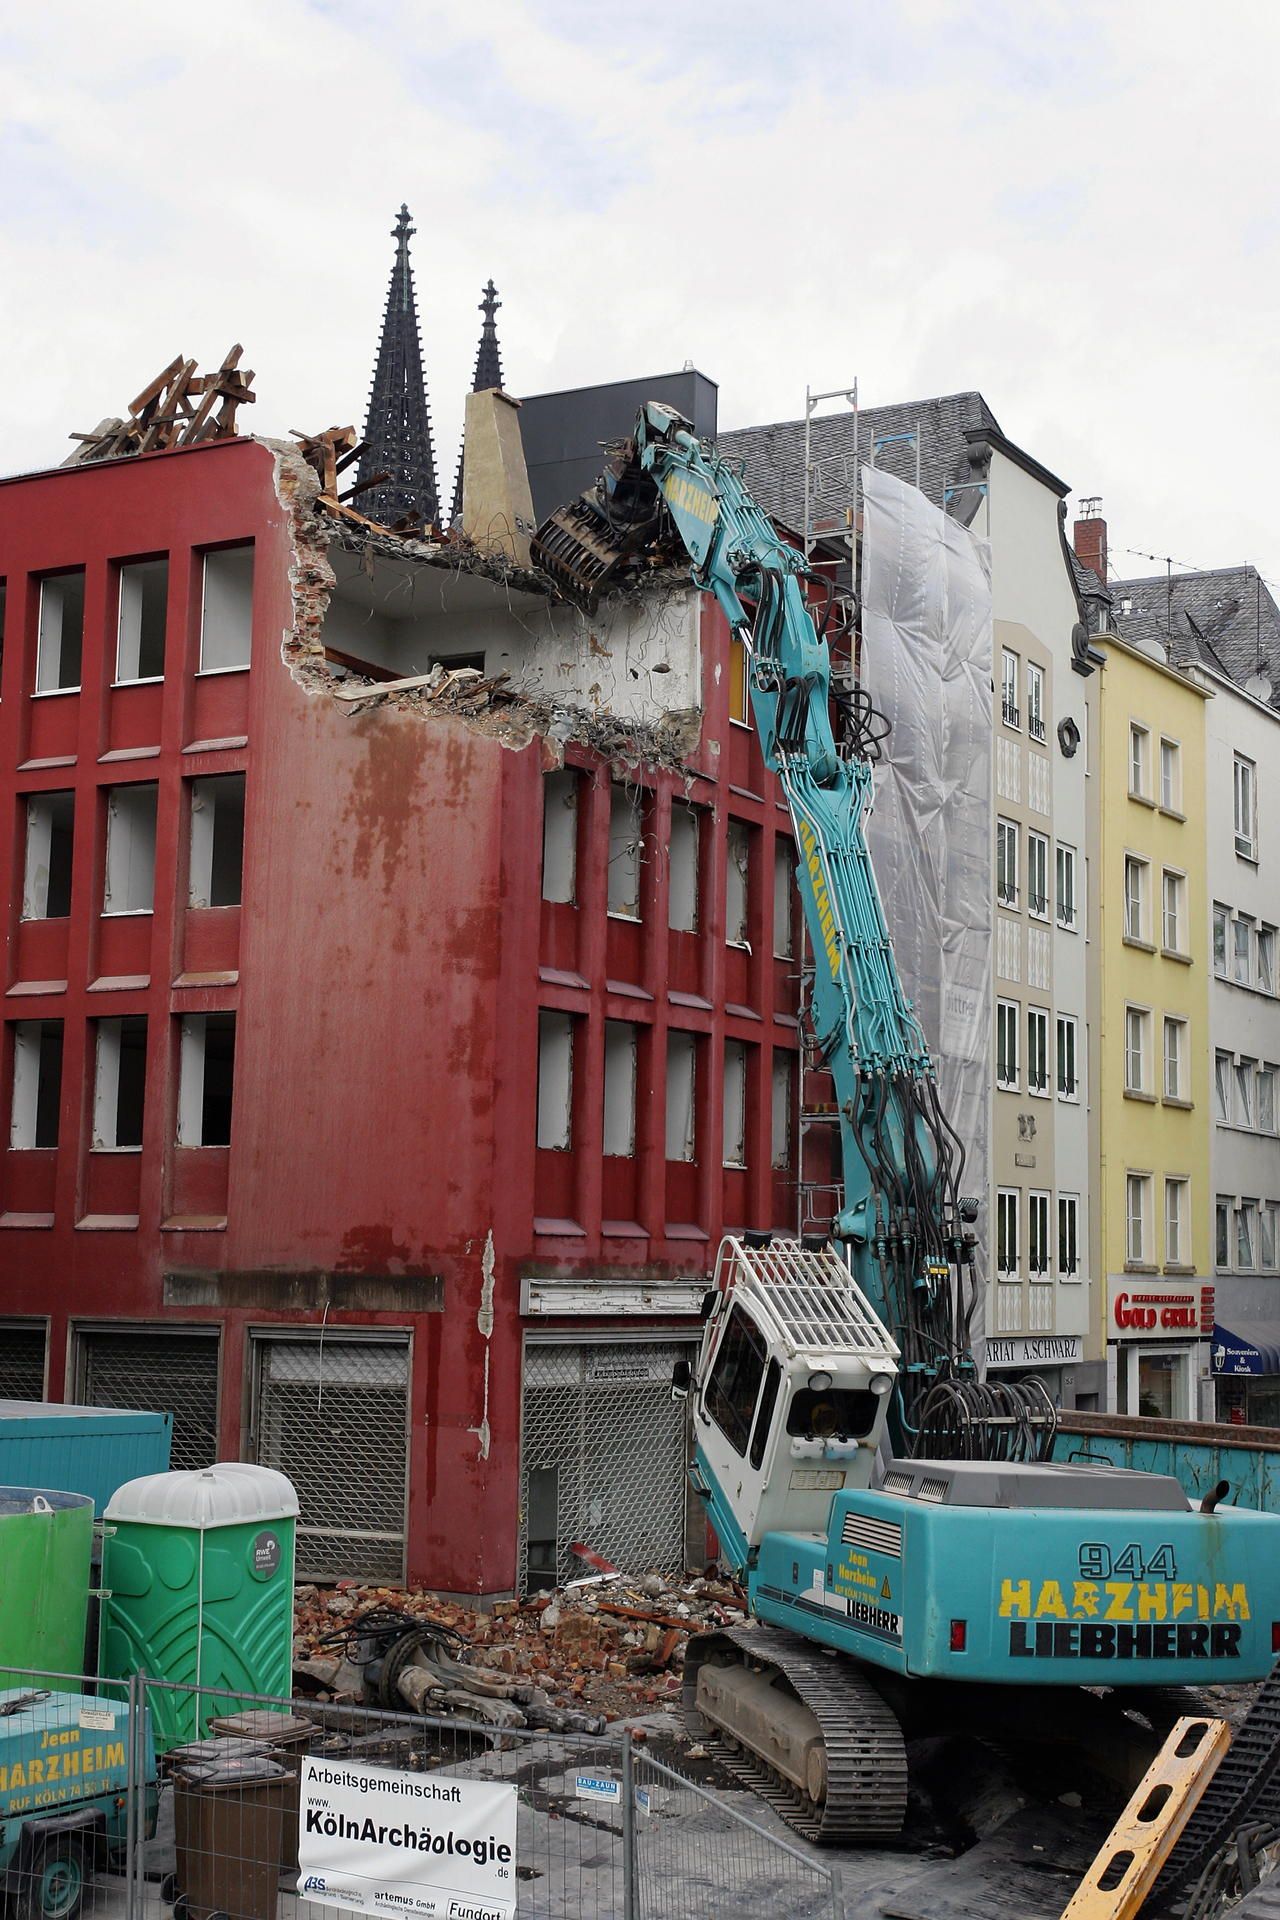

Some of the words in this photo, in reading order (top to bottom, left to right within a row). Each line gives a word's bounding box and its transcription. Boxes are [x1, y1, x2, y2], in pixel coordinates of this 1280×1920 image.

[1078, 1541, 1177, 1581] 944
[847, 1598, 899, 1634] LIEBHERR
[1008, 1621, 1241, 1658] LIEBHERR
[41, 1729, 80, 1749] Jean
[307, 1766, 462, 1803] Arbeitsgemeinschaft
[9, 1796, 31, 1812] RUF
[34, 1788, 66, 1806] KÖLN
[307, 1797, 331, 1808] www.
[306, 1808, 512, 1865] KölnArchäologie
[494, 1866, 509, 1879] .de
[374, 1891, 414, 1906] artemus
[415, 1899, 436, 1911] GmbH
[449, 1902, 501, 1920] Fundort
